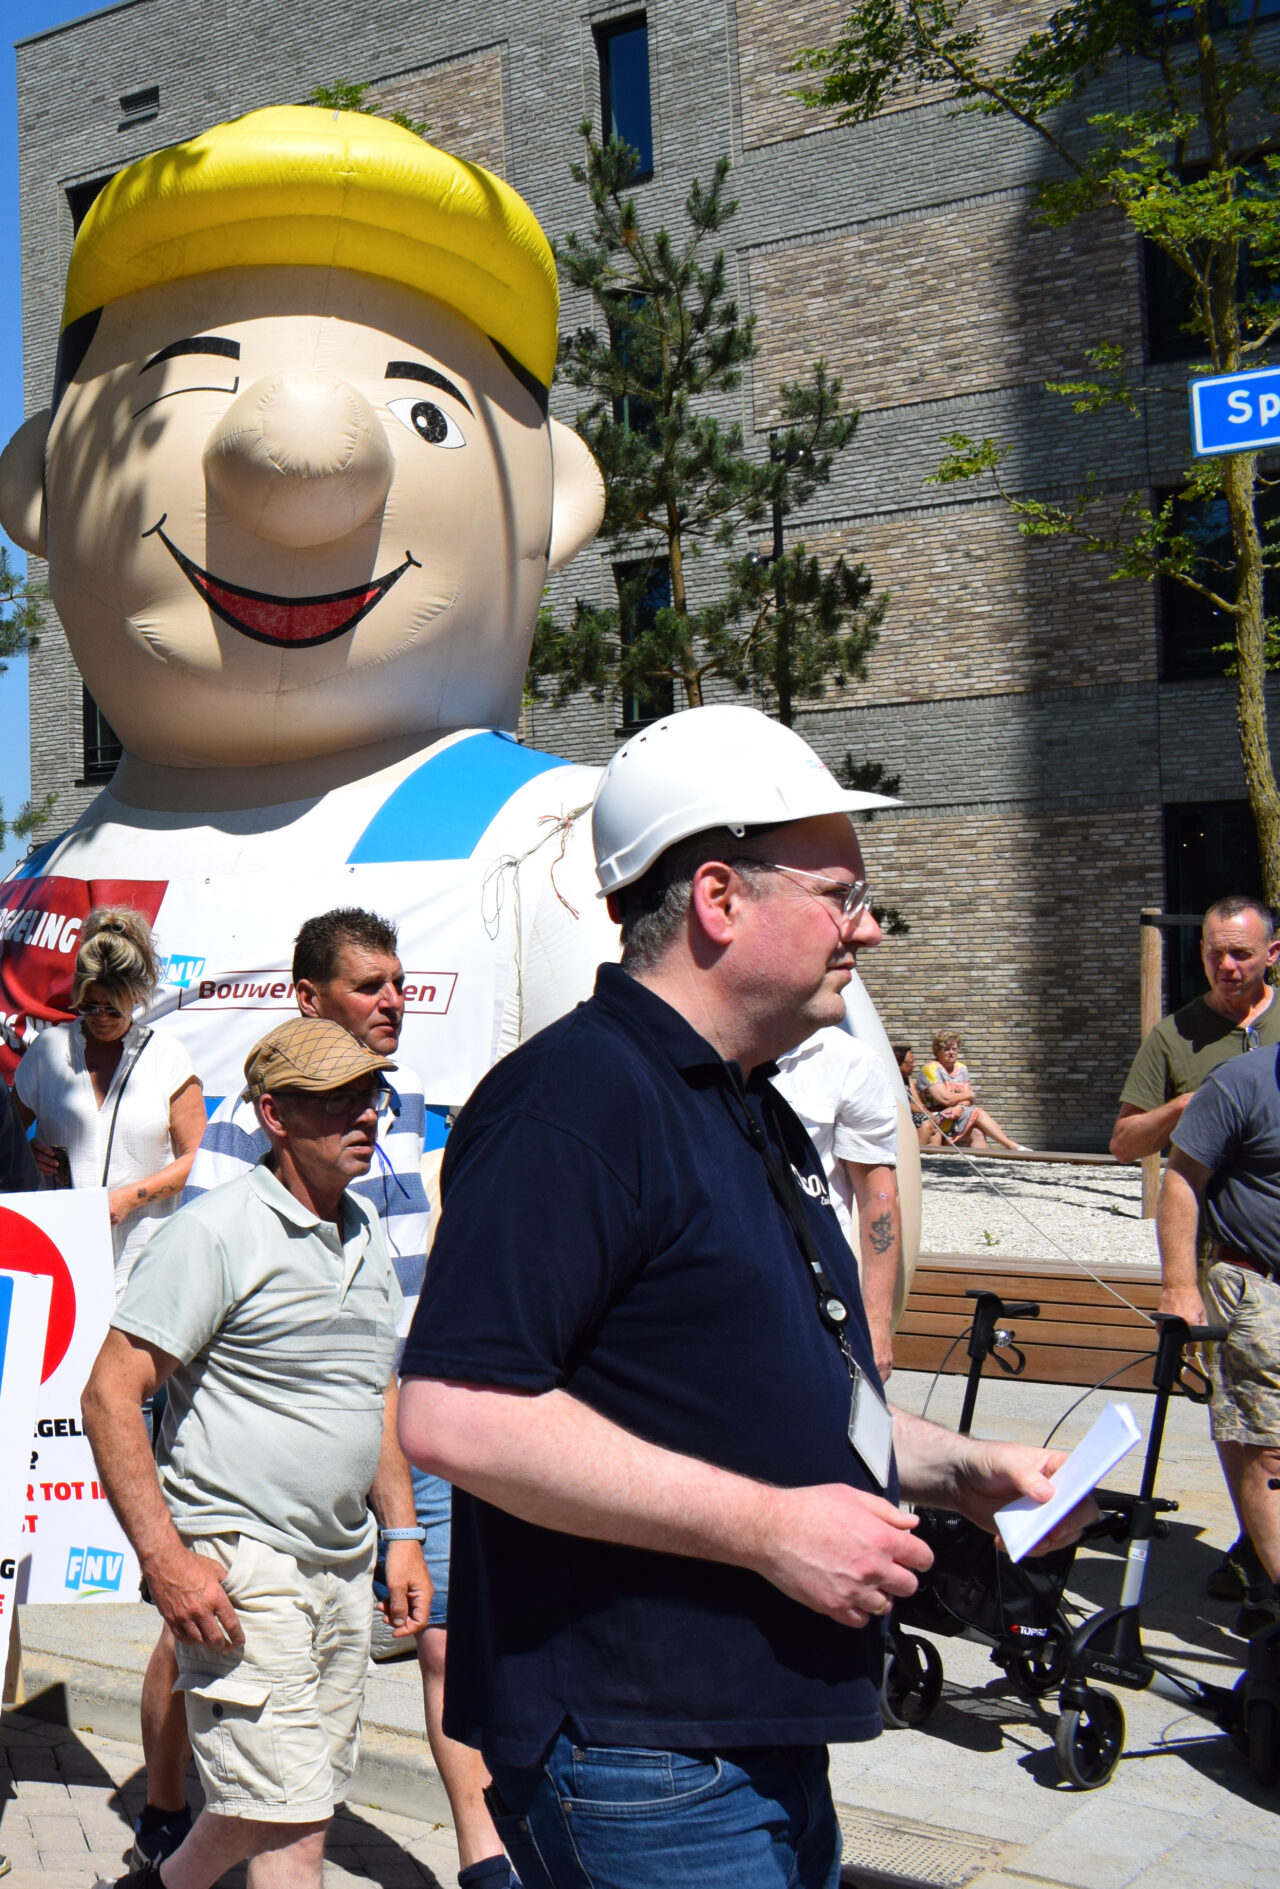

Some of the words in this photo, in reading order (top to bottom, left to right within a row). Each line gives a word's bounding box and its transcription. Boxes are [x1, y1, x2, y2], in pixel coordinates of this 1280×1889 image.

[34, 1418, 86, 1438] GEL
[40, 1481, 85, 1501] TOT
[67, 1554, 124, 1582] FNV
